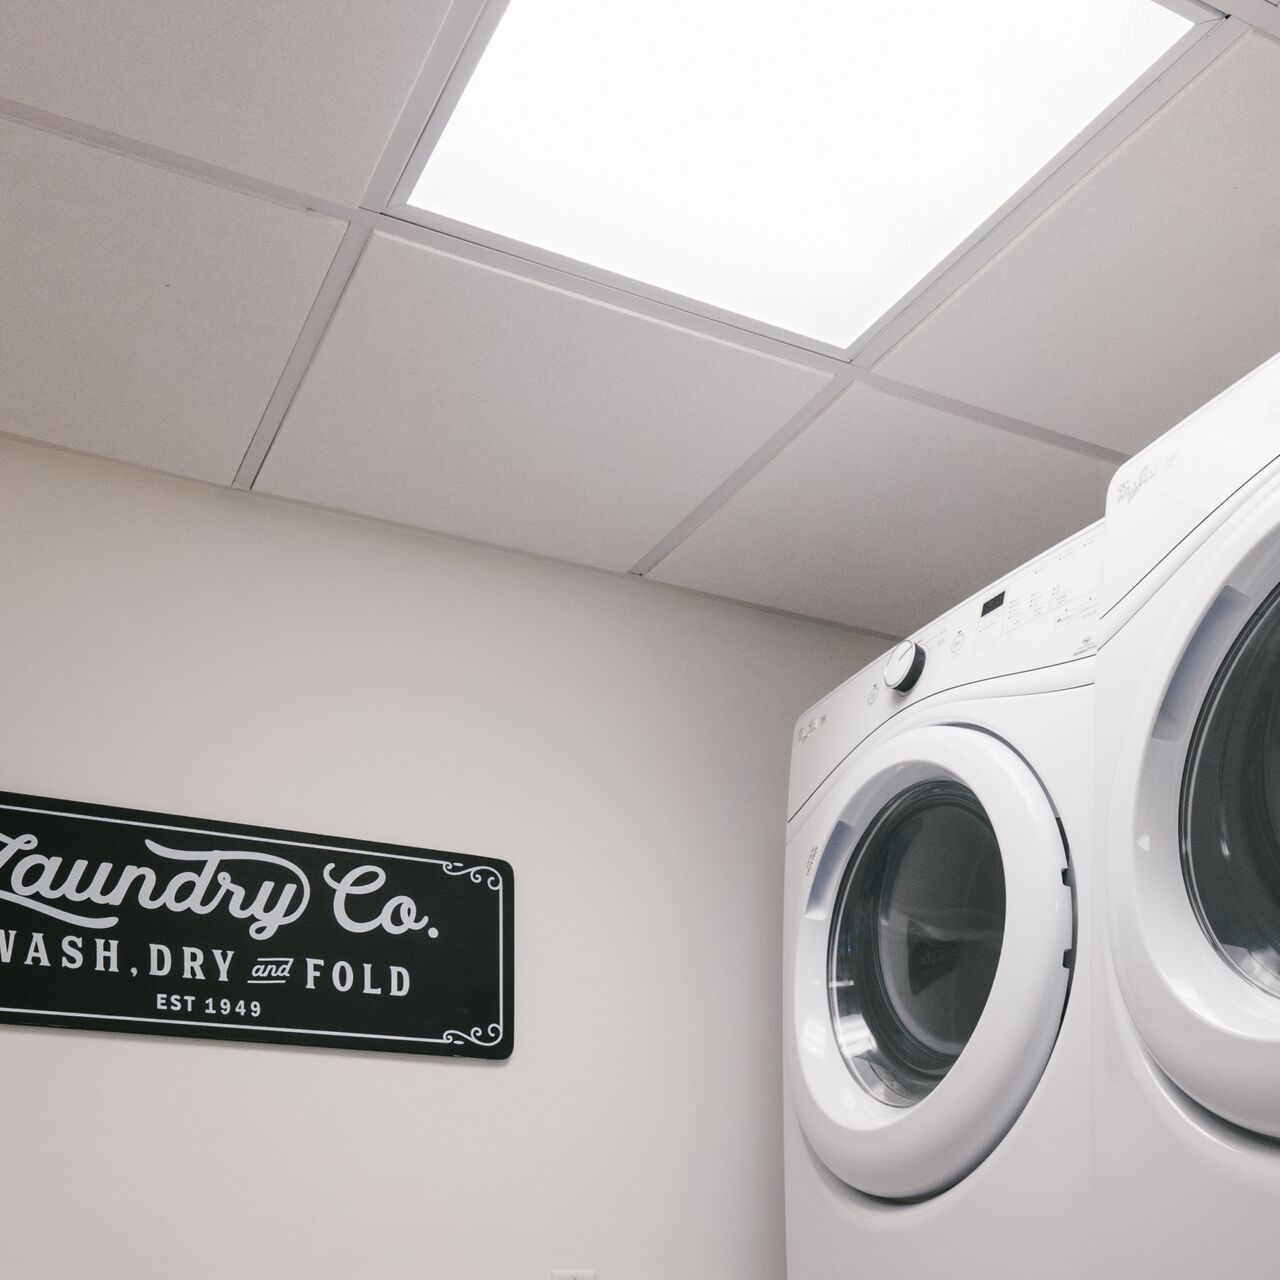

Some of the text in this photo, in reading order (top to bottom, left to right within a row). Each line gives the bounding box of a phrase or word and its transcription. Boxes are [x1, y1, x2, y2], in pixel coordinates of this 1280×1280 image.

[323, 863, 439, 938] Co.
[149, 944, 235, 982] DRY
[247, 957, 294, 984] and
[305, 957, 410, 997] FOLD
[156, 994, 261, 1017] EST 1949
